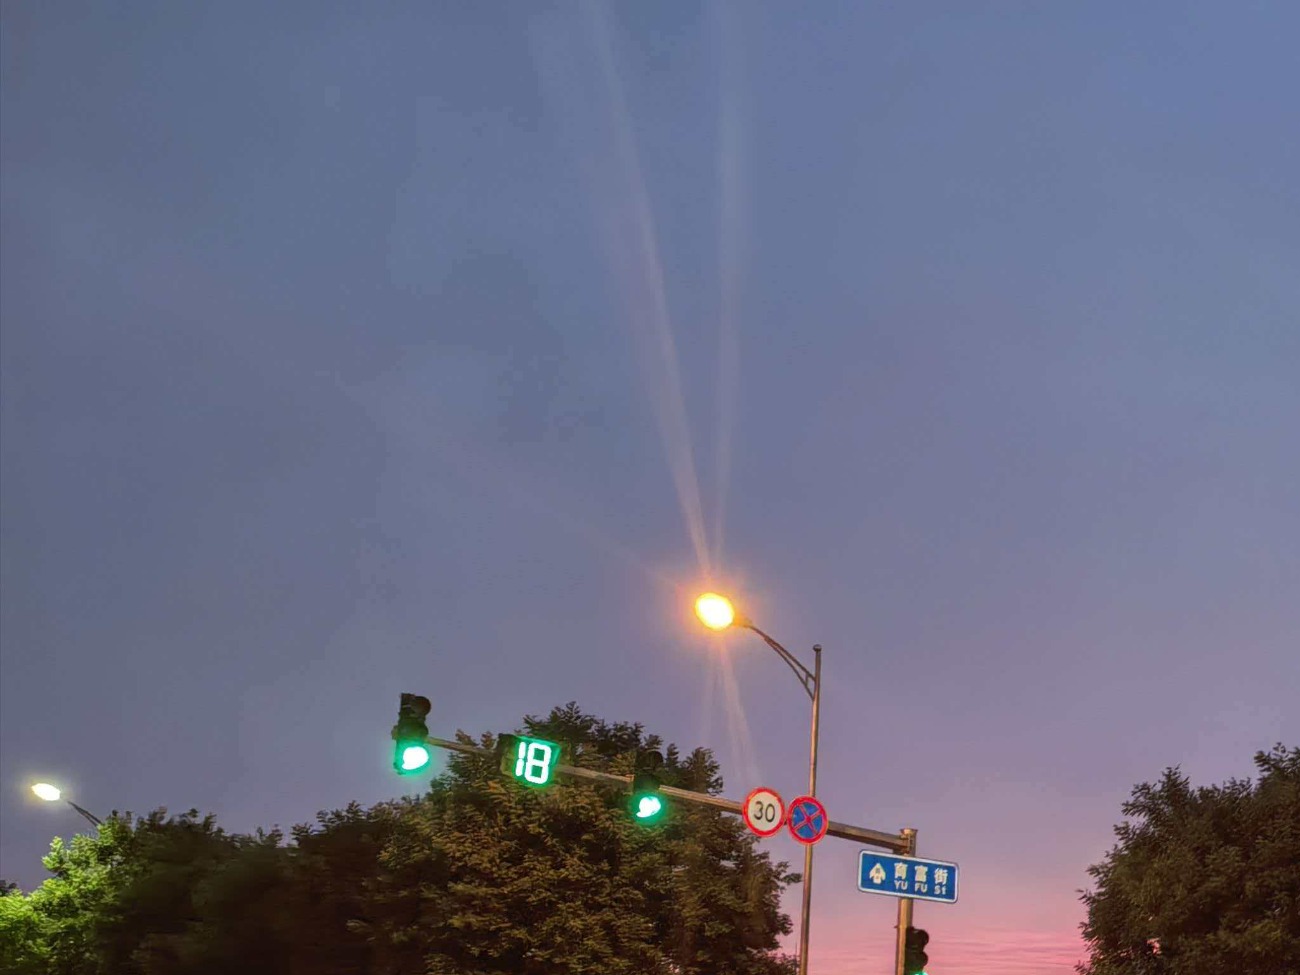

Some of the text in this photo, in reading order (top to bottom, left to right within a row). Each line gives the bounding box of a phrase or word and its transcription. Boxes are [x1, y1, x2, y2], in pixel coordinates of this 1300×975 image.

[515, 741, 552, 785] 18
[753, 800, 776, 823] 30
[893, 880, 908, 890] YU
[914, 882, 928, 893] FU
